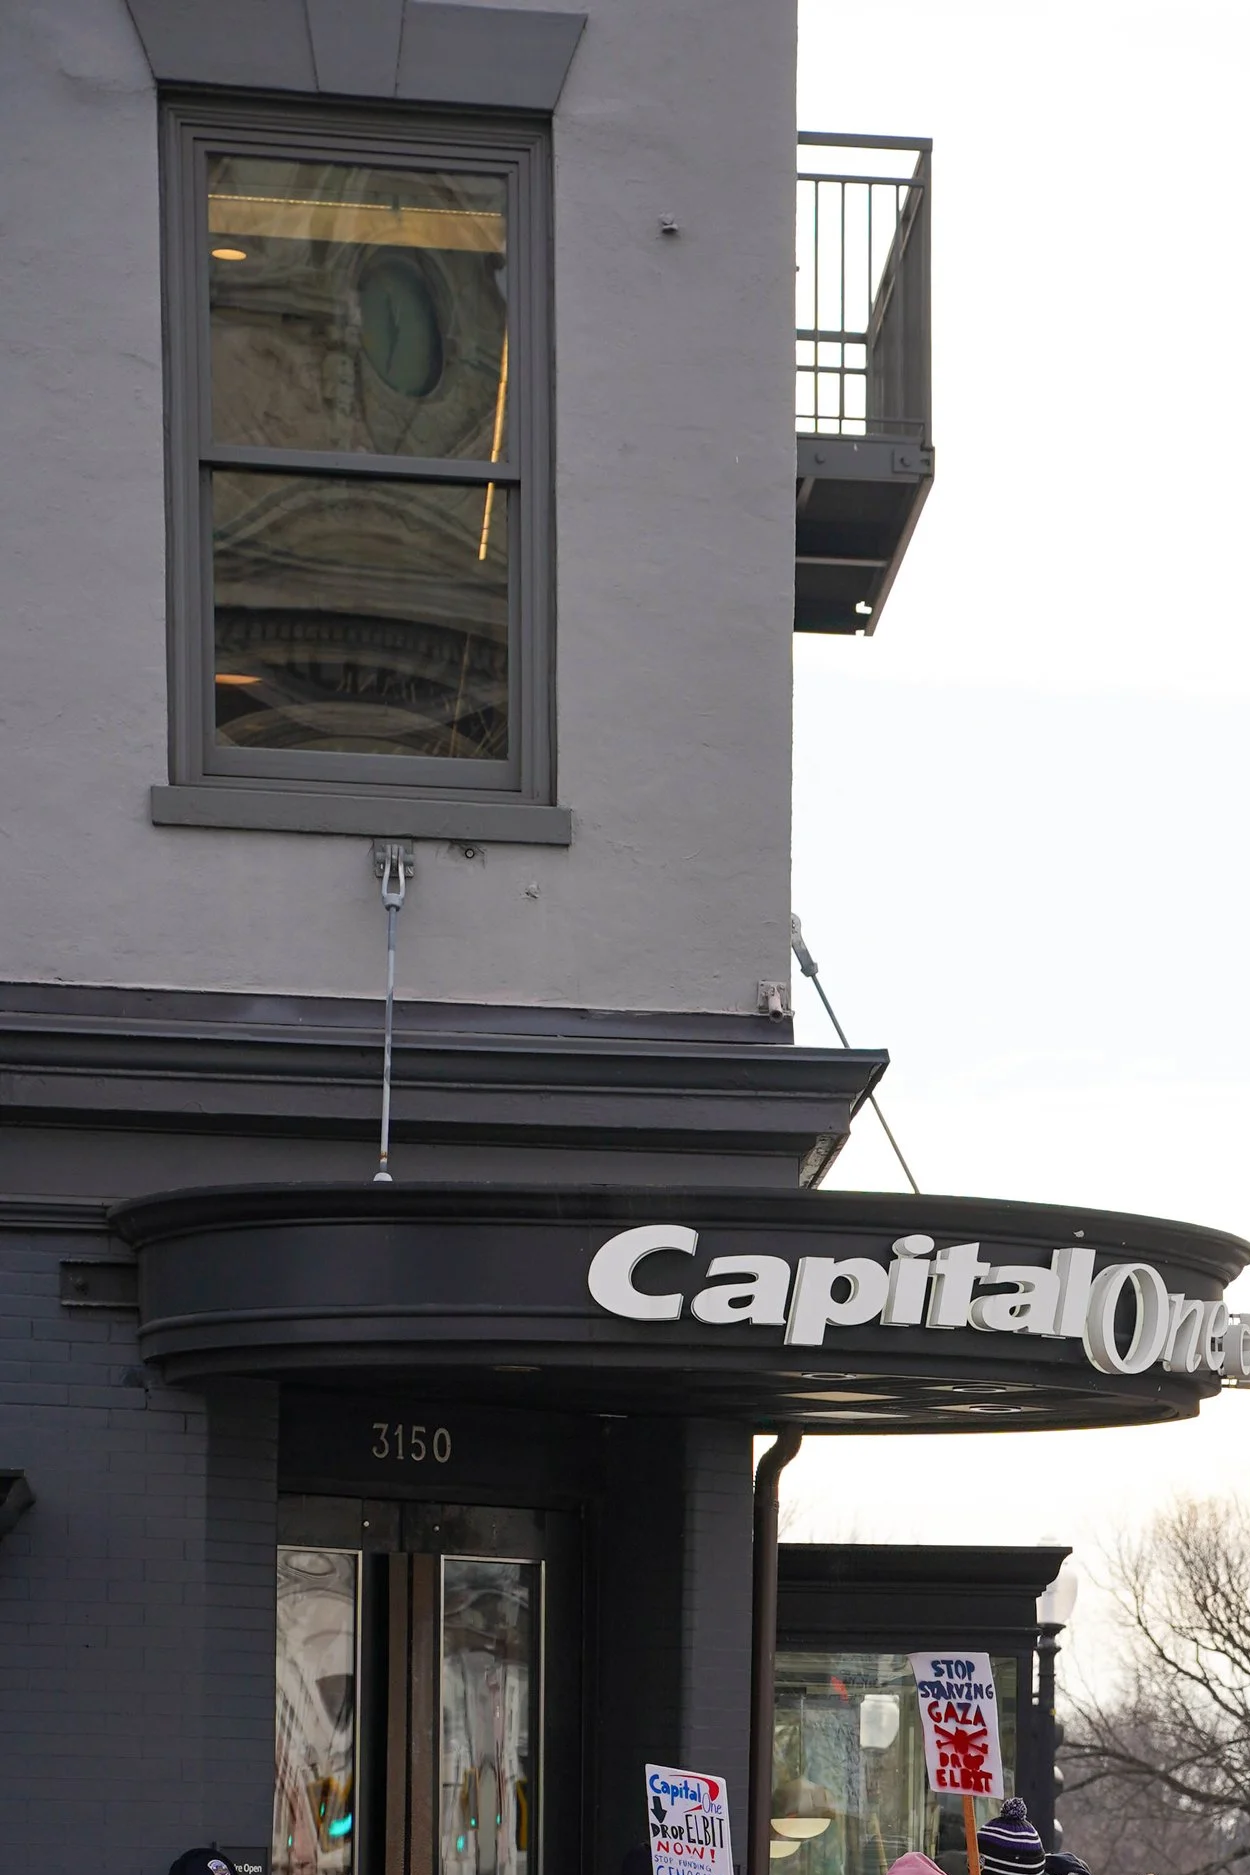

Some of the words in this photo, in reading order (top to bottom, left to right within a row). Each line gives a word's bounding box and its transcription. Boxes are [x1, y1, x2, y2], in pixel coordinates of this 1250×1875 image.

[588, 1224, 1096, 1347] Capital
[1083, 1261, 1228, 1375] One
[372, 1422, 452, 1463] 3150
[931, 1660, 975, 1681] STOP
[918, 1680, 994, 1700] STARVING
[927, 1701, 987, 1727] GAZA
[939, 1752, 984, 1770] DROP
[935, 1768, 993, 1792] ELBIT
[649, 1773, 701, 1806] Capital
[702, 1792, 722, 1815] One
[651, 1822, 685, 1840] DROP
[685, 1814, 724, 1848] ELBIT
[654, 1855, 674, 1864] STOP
[678, 1860, 712, 1872] FUNDING
[656, 1841, 716, 1863] NOW!
[243, 1863, 262, 1874] Open
